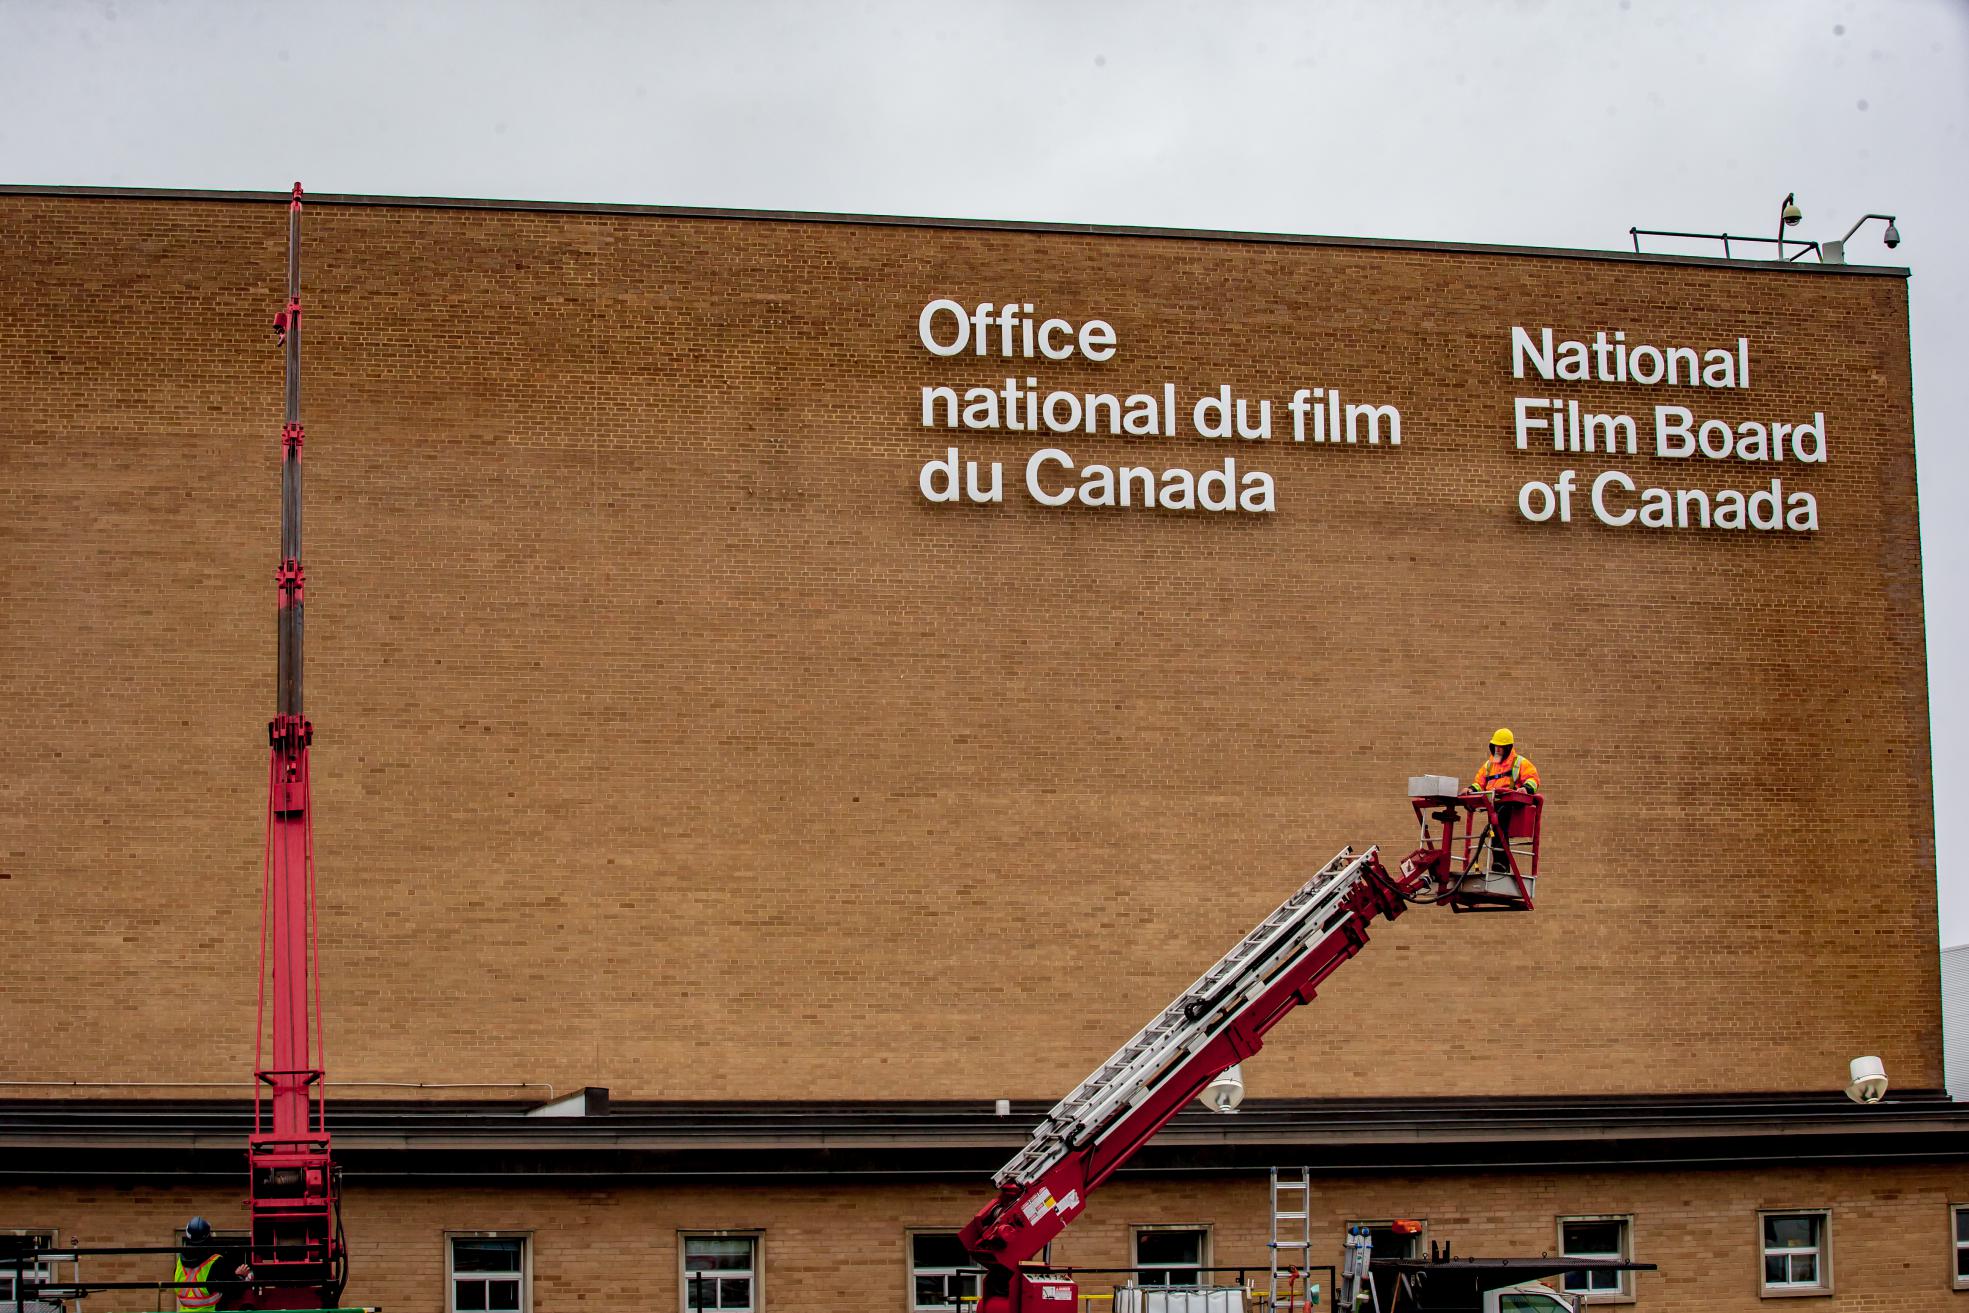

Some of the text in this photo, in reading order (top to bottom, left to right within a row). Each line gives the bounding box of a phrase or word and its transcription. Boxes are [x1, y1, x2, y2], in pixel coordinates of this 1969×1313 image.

[918, 298, 1117, 362] Office
[1511, 326, 1750, 389] National
[922, 376, 1401, 445] national du film
[1514, 397, 1827, 463] Film Board
[919, 446, 1276, 512] du Canada
[1518, 469, 1819, 531] of Canada
